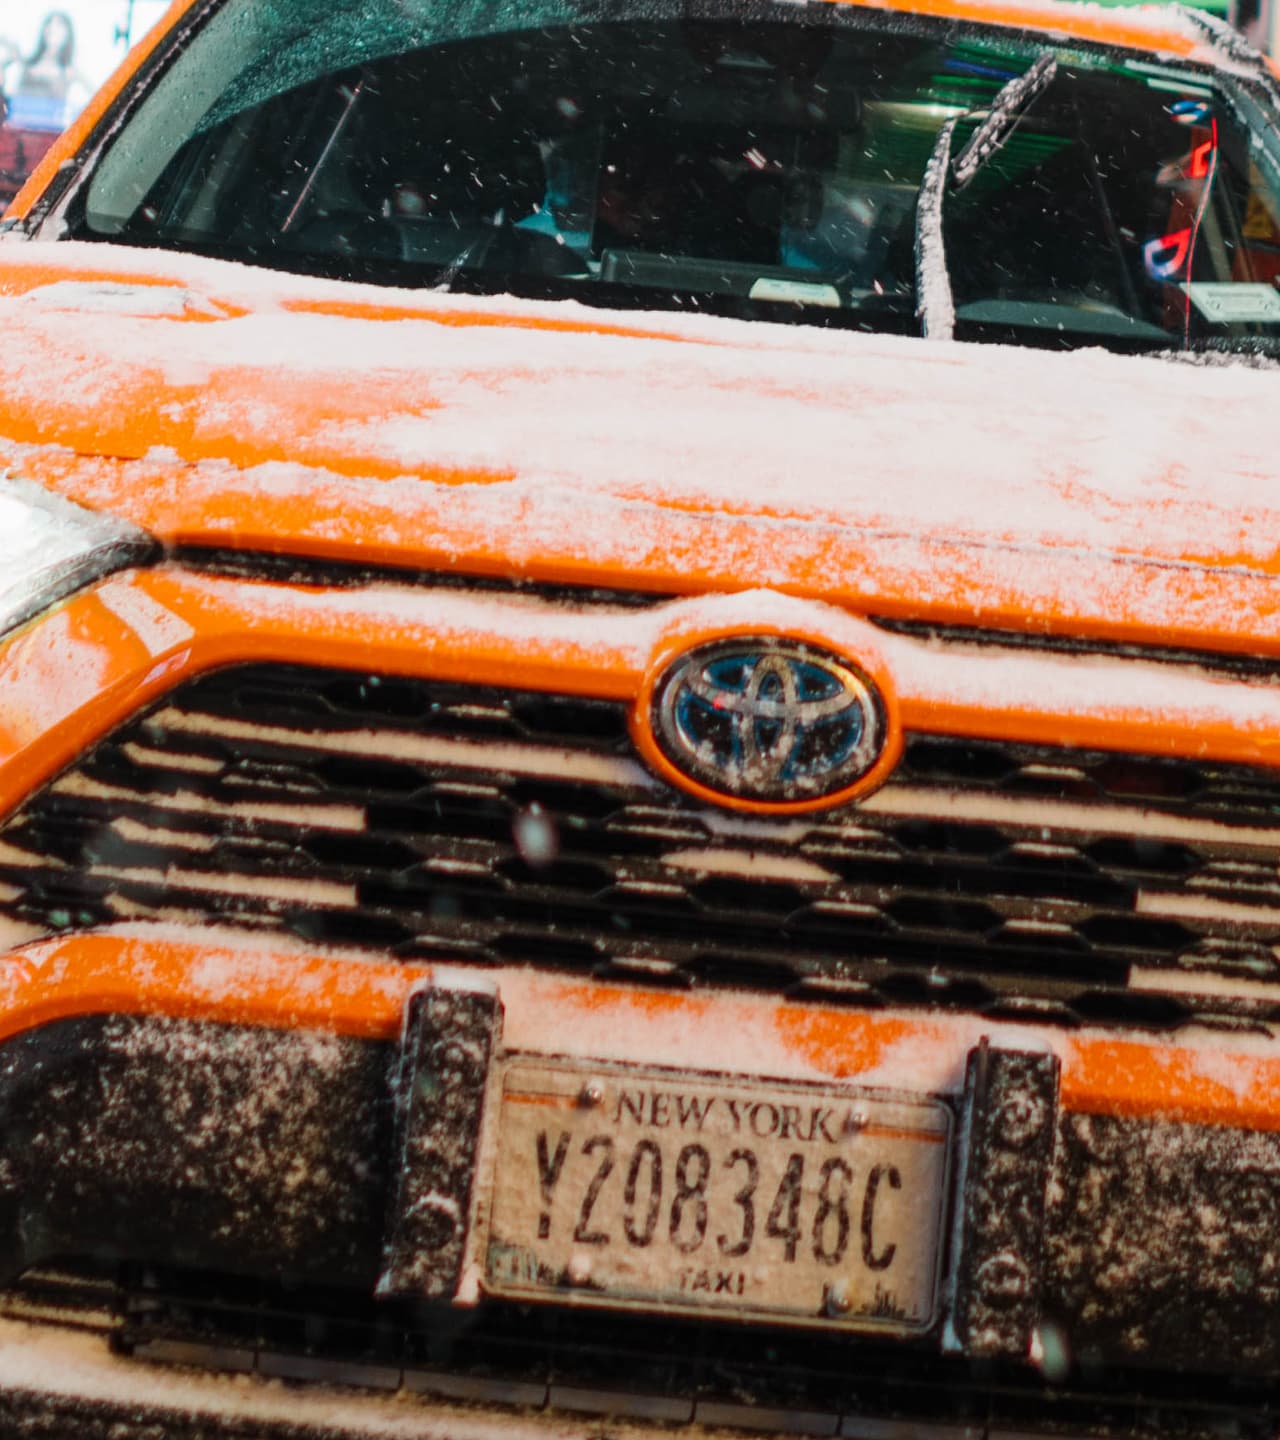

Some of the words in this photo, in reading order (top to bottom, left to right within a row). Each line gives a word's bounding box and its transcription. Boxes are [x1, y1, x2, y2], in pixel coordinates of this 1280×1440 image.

[617, 1090, 716, 1129] NEW
[725, 1099, 839, 1143] YORK
[536, 1130, 902, 1271] Y208348C
[679, 1268, 746, 1295] TAXI
